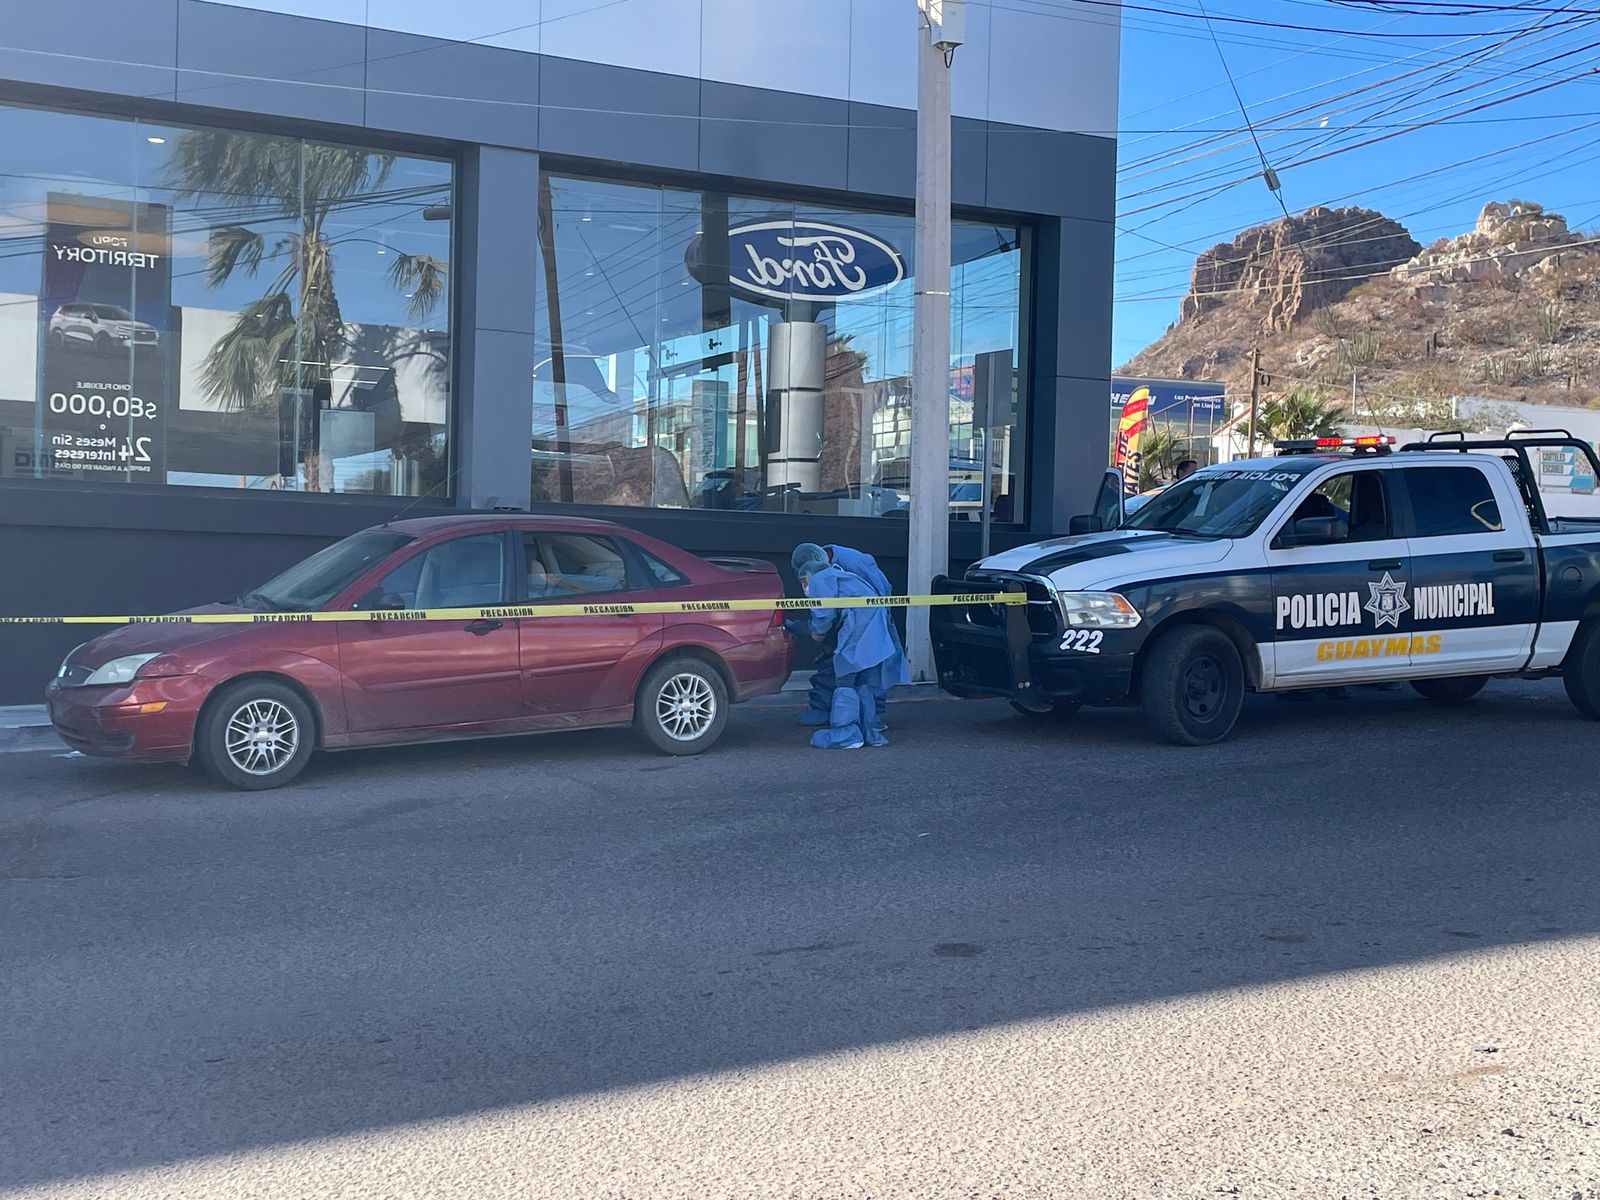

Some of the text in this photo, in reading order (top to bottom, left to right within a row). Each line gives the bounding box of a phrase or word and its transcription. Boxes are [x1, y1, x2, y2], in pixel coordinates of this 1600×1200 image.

[370, 611, 427, 621] PRECAUCION
[480, 607, 534, 618] PRECAUCION
[583, 604, 635, 614] PRECAUCION
[681, 602, 730, 611] PRECAUCION
[775, 600, 822, 608] PRECAUCION
[866, 596, 911, 605] PRECAUCION
[952, 594, 995, 603] PRECAUCION
[1276, 582, 1495, 630] POLICIA MUNICIPAL
[1060, 629, 1104, 654] 222
[1316, 633, 1443, 662] GUAYMAS
